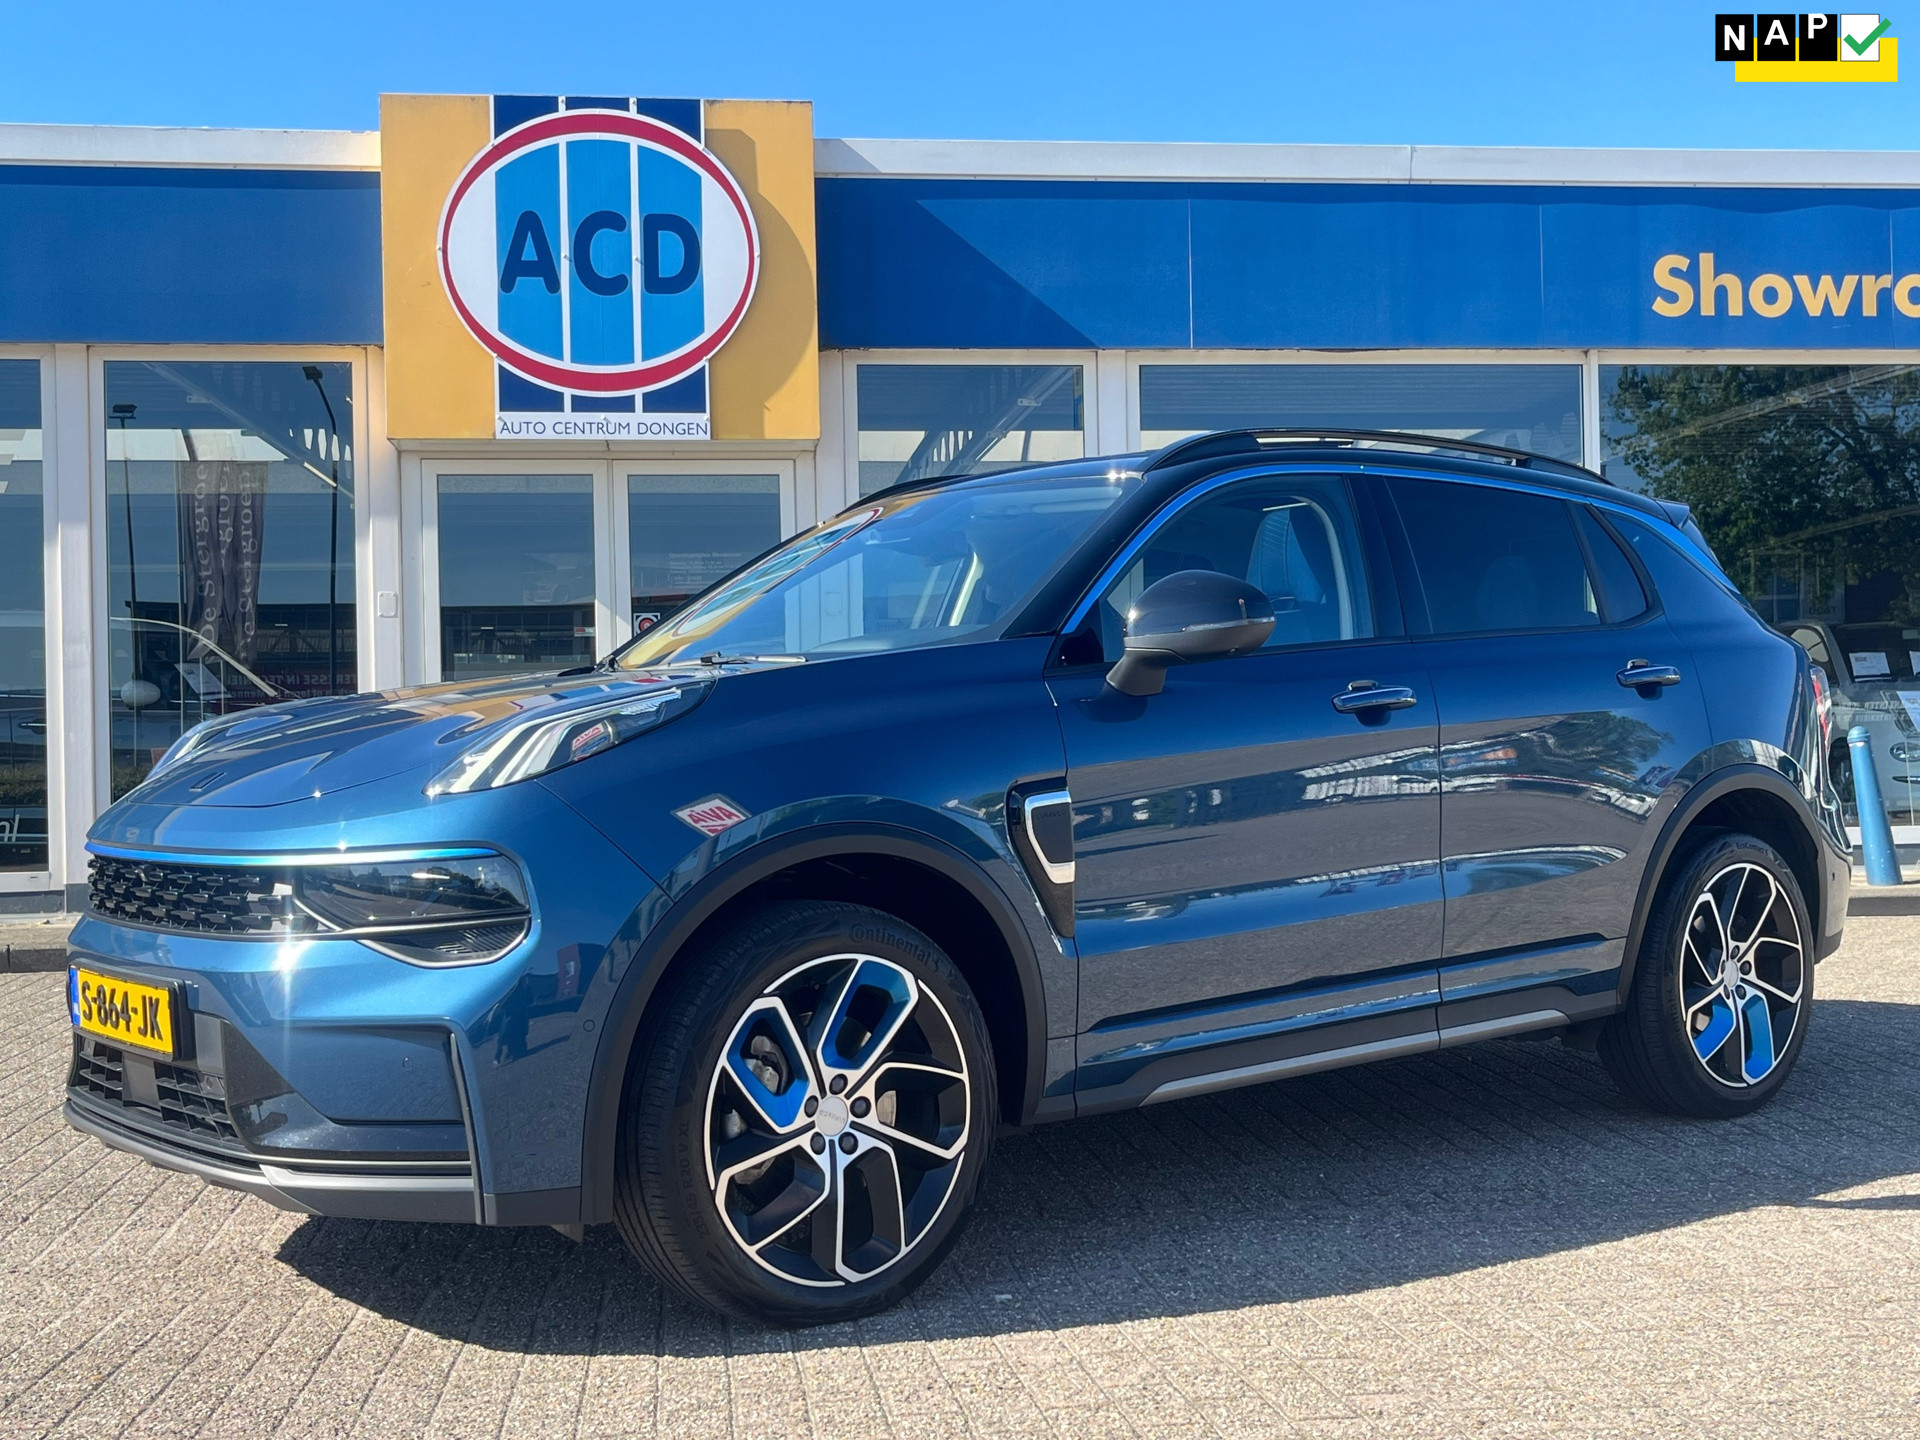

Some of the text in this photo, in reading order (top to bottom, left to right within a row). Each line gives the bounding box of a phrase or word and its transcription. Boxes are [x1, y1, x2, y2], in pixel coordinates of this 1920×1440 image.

[500, 209, 701, 296] ACD
[1652, 252, 1920, 318] Showro
[500, 421, 708, 436] AUTO CENTRUM DONGEN
[81, 980, 164, 1042] S-864-JK
